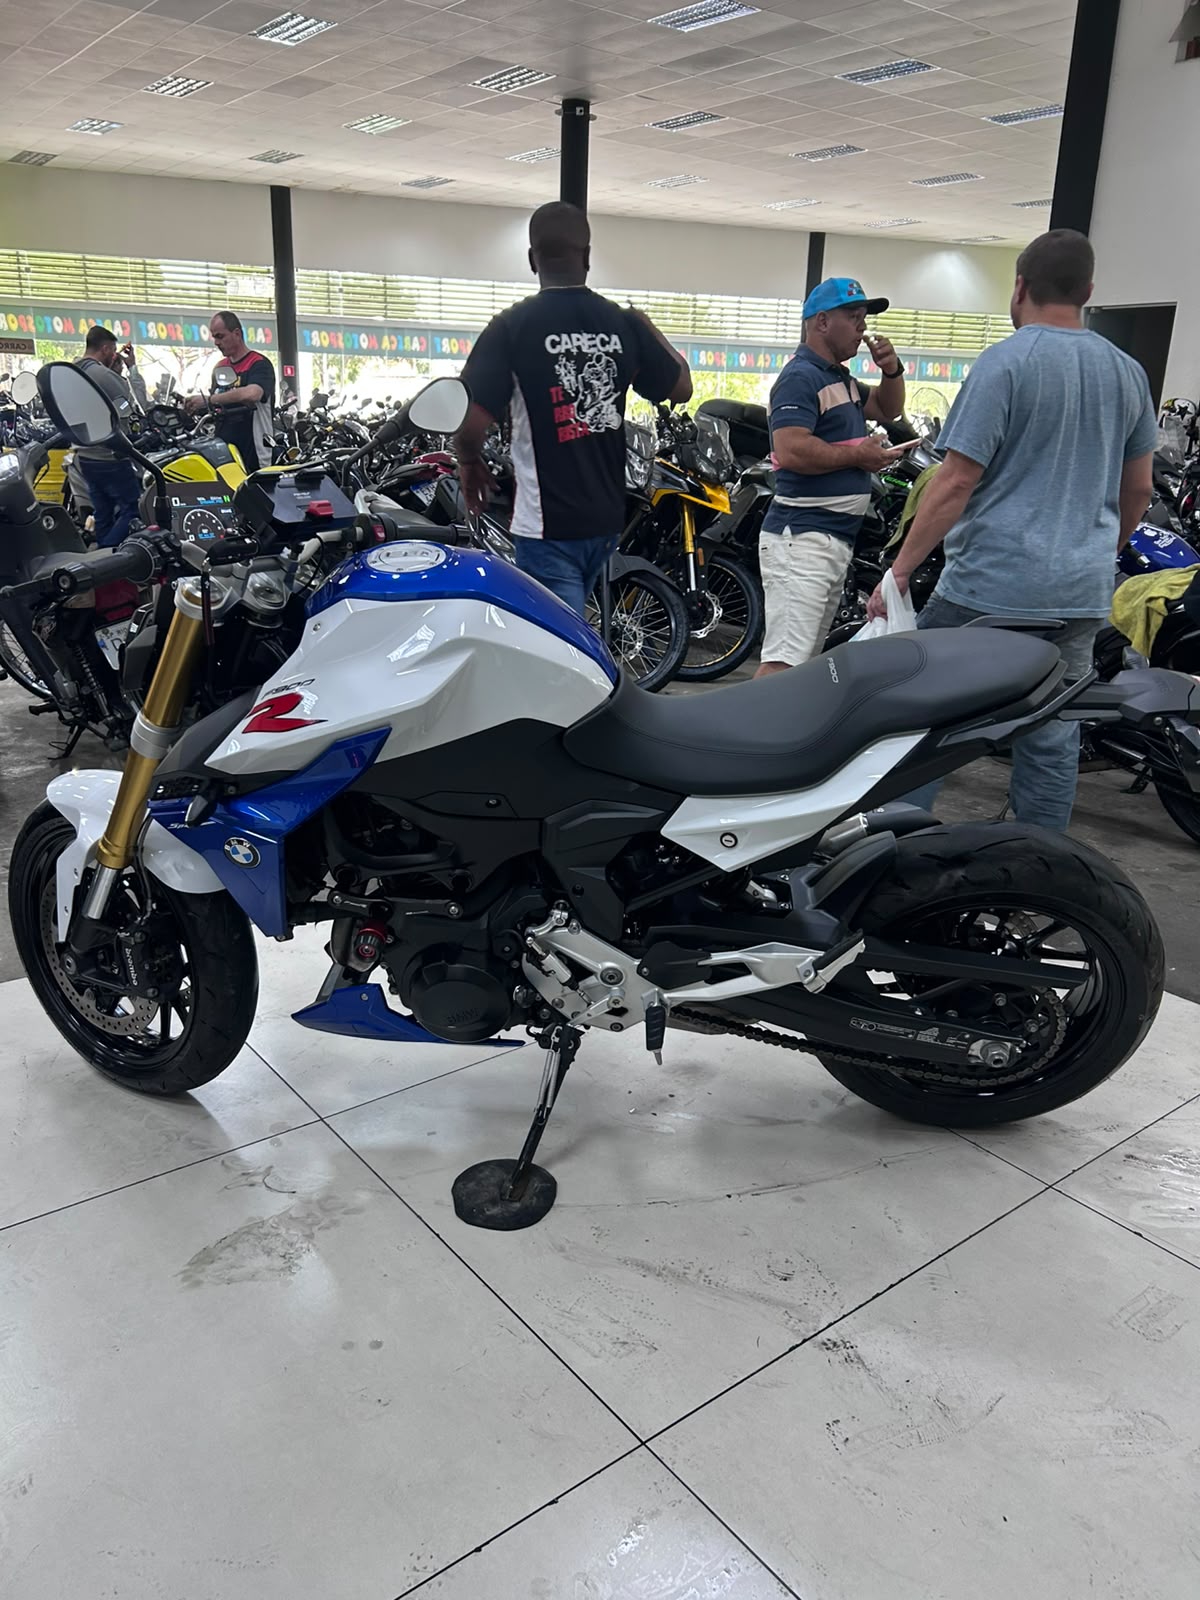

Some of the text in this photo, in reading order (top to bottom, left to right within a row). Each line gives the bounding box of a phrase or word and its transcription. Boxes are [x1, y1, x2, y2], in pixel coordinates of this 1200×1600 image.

[544, 331, 624, 354] CARECA
[549, 385, 564, 403] TE
[171, 497, 180, 507] 0
[827, 657, 839, 683] F900
[261, 678, 316, 700] F900
